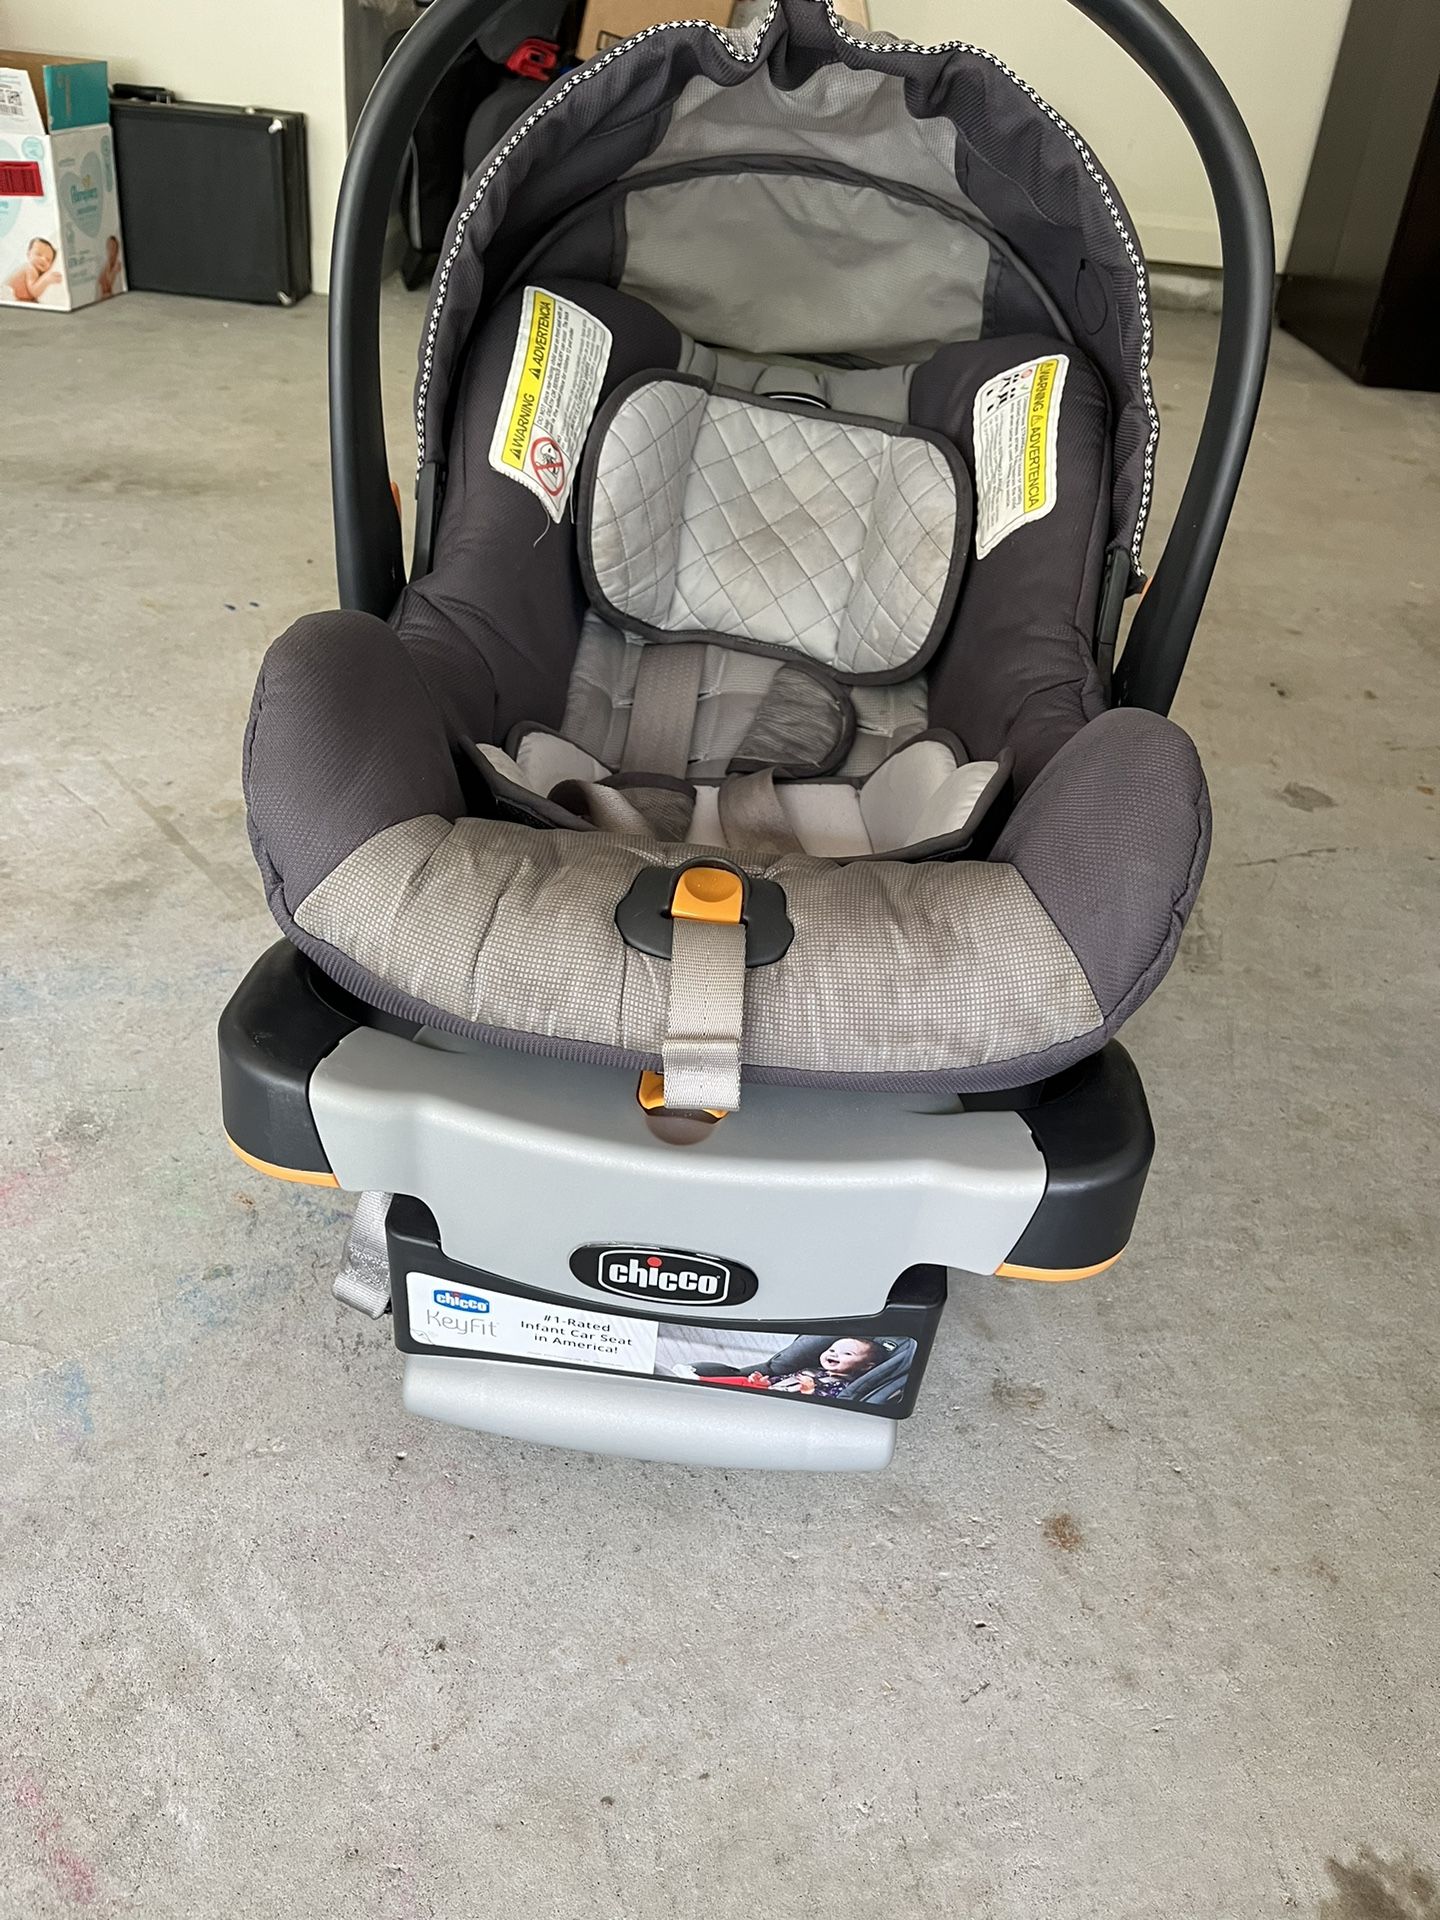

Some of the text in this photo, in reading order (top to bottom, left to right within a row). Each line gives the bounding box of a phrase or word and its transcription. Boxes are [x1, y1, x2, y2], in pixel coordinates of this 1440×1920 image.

[512, 301, 551, 447] WARNING ADVERTENCIA
[1028, 369, 1051, 508] WARNING ADVERTENCIA
[609, 1256, 719, 1295] chicco
[435, 1290, 488, 1312] chicco
[521, 1320, 633, 1346] Infant Car Seat
[534, 1334, 618, 1354] in America!
